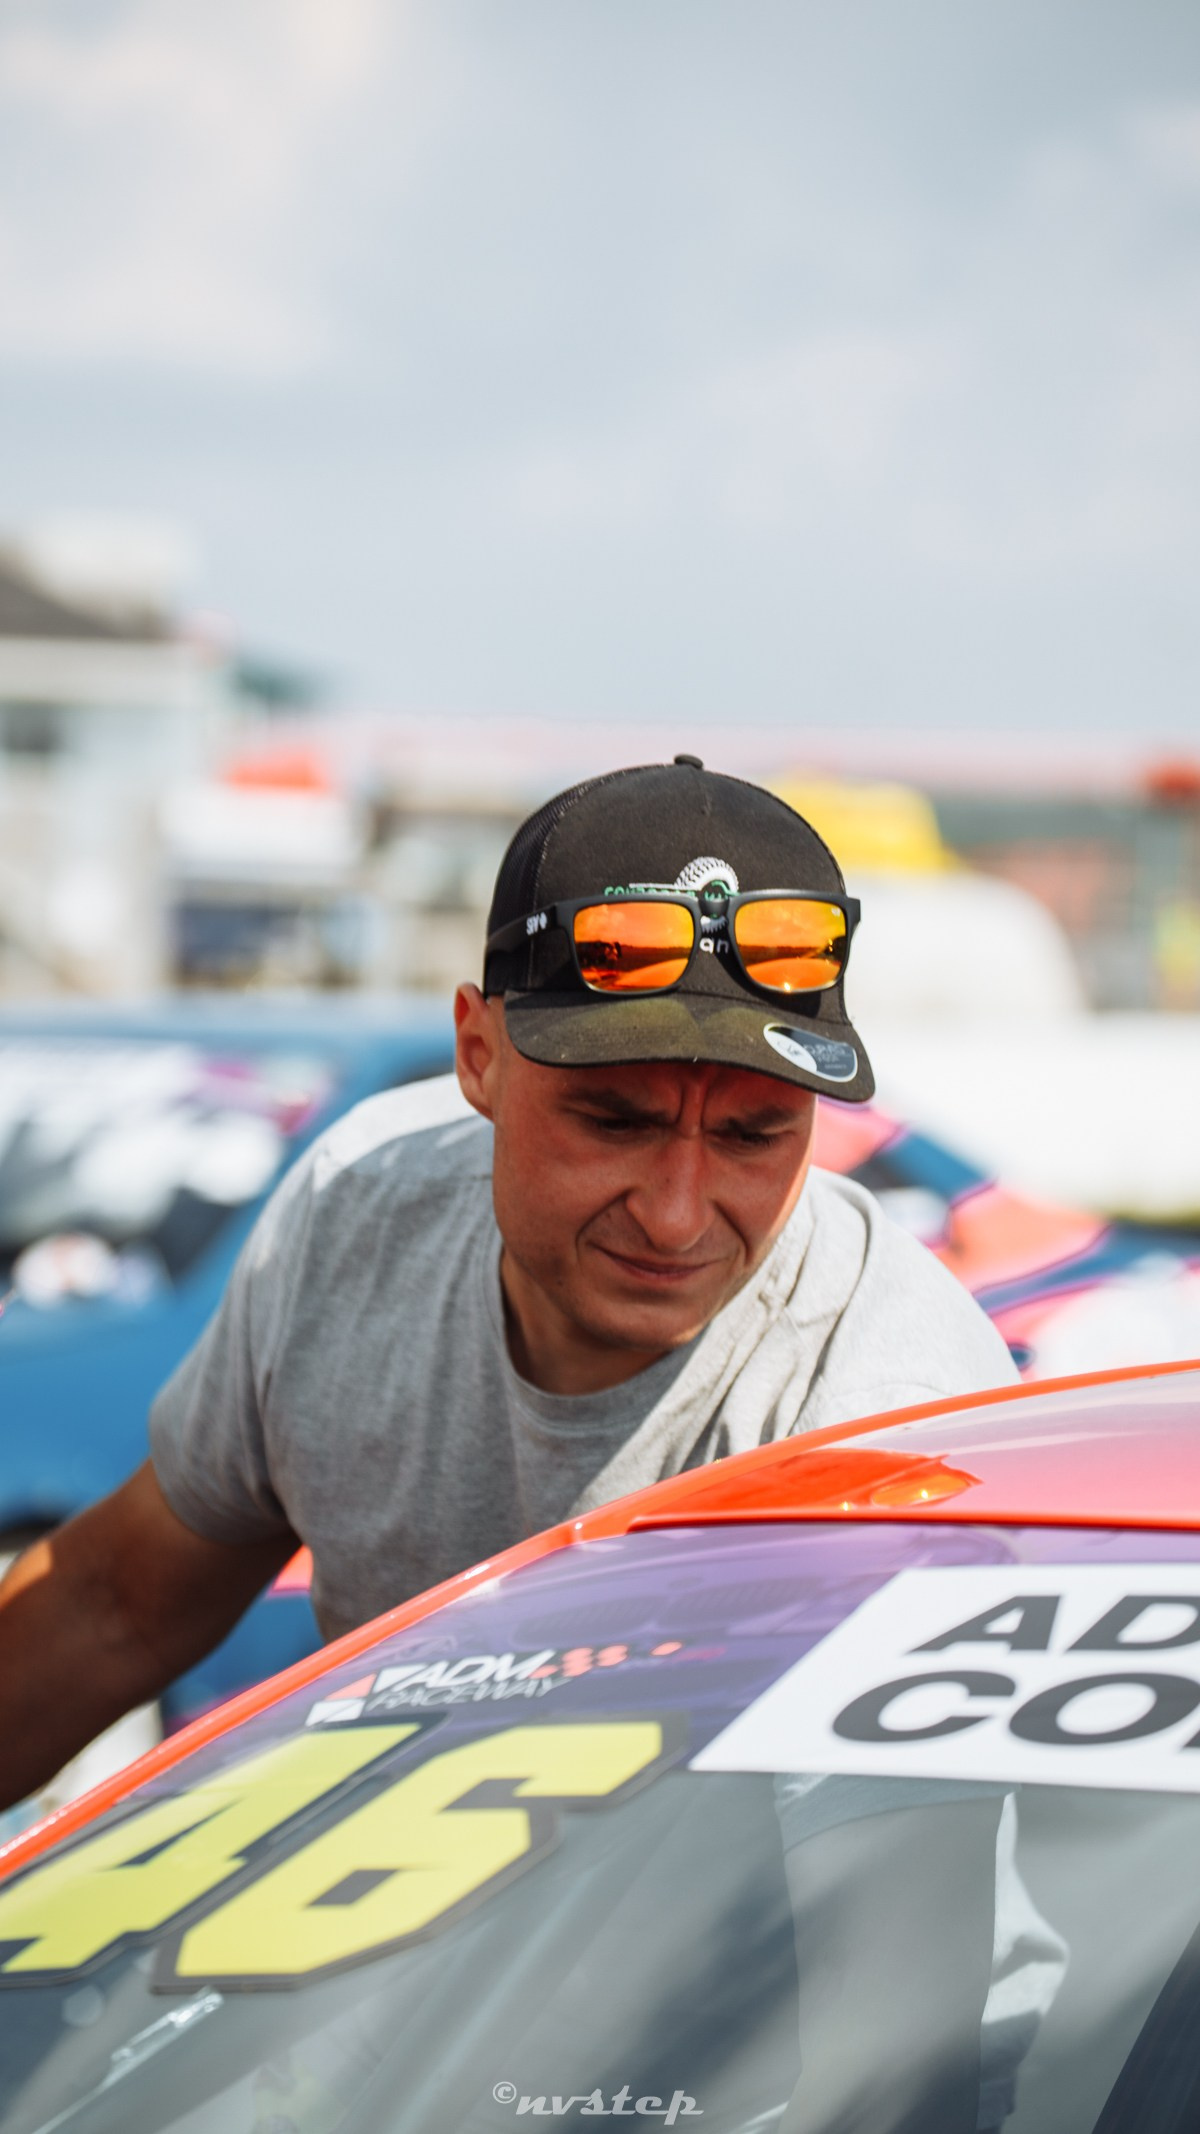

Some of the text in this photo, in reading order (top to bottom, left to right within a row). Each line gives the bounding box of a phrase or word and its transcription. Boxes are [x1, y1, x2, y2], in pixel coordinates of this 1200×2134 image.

[366, 1675, 572, 1711] RACEWAY
[397, 1650, 556, 1693] ADM
[832, 1670, 1200, 1750] CO
[0, 1722, 661, 1976] 46
